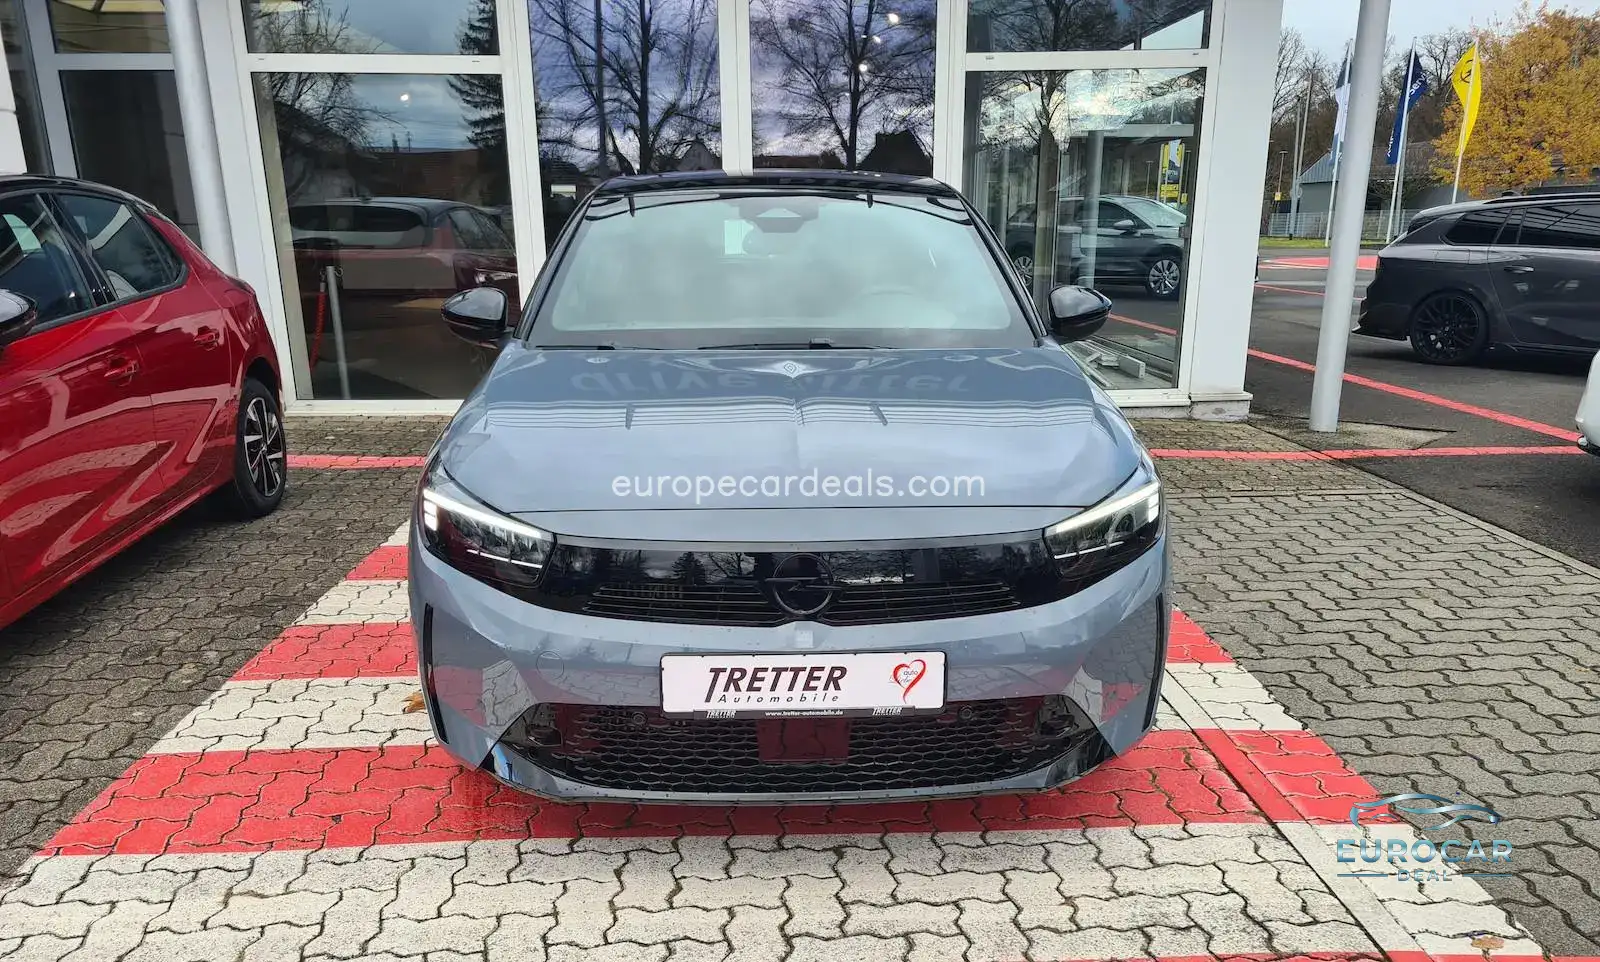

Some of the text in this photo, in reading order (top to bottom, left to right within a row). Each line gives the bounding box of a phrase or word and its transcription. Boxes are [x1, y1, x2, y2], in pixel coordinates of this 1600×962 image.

[704, 666, 848, 703] TRETTER
[717, 692, 839, 703] Automobile
[706, 710, 737, 719] TRETTER
[765, 709, 844, 717] www.tretter-automobile.de
[872, 706, 902, 716] TRETTER
